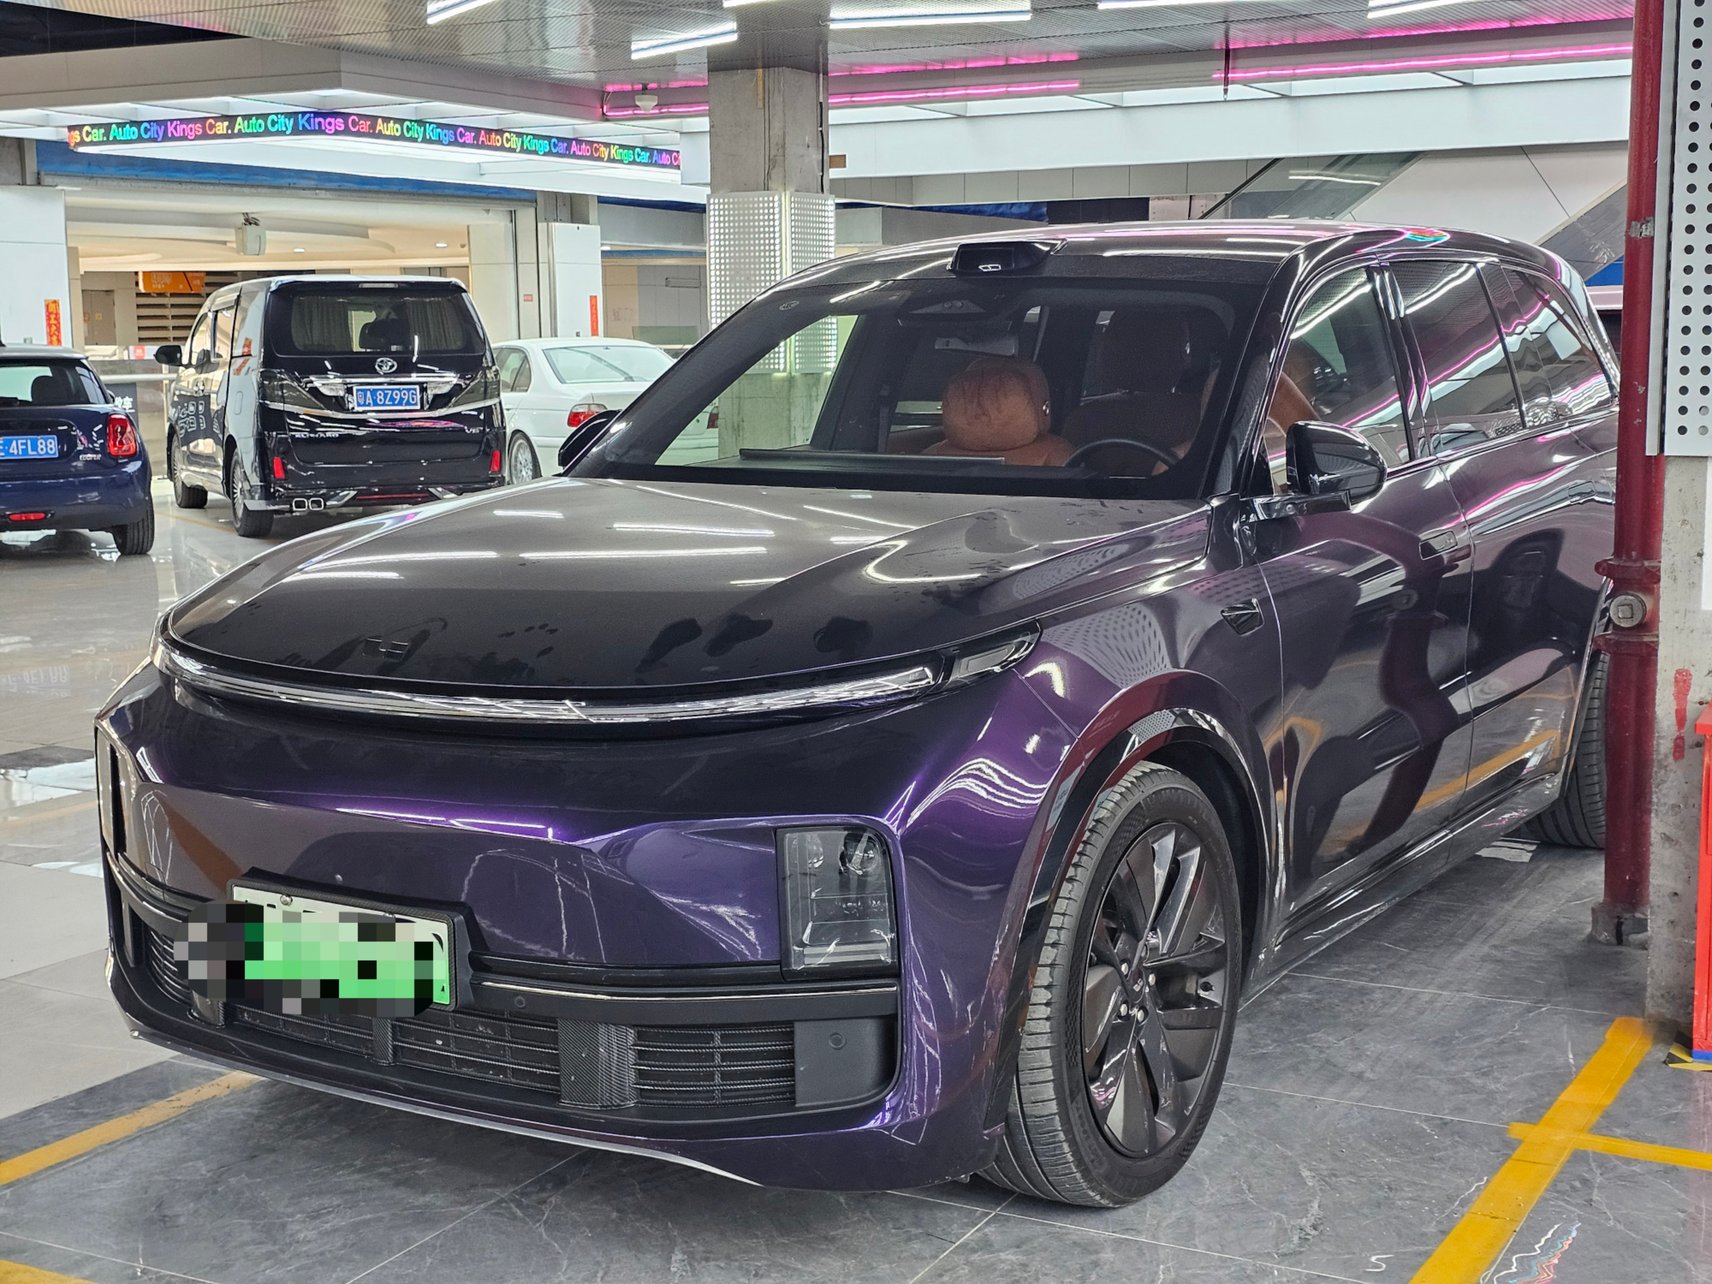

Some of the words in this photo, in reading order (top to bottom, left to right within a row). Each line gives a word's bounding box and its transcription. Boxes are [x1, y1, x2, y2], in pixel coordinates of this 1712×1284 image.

[82, 125, 107, 142] Car.
[109, 124, 138, 141] Auto
[140, 122, 165, 141] City
[167, 120, 202, 139] Kings
[206, 118, 231, 134] Car.
[234, 116, 264, 133] Auto
[267, 114, 294, 135] City
[298, 113, 345, 134] Kings
[348, 115, 373, 133] Car.
[376, 118, 401, 136] Auto
[403, 121, 424, 142] City
[425, 123, 455, 145] Kings
[456, 127, 477, 144] Car.
[479, 130, 502, 146] Auto
[503, 132, 522, 152] City
[523, 134, 550, 155] Kings
[550, 138, 569, 154] Car.
[570, 140, 591, 156] Auto
[592, 143, 610, 161] City
[610, 145, 634, 164] Kings
[634, 147, 651, 163] Car.
[652, 150, 671, 165] Auto
